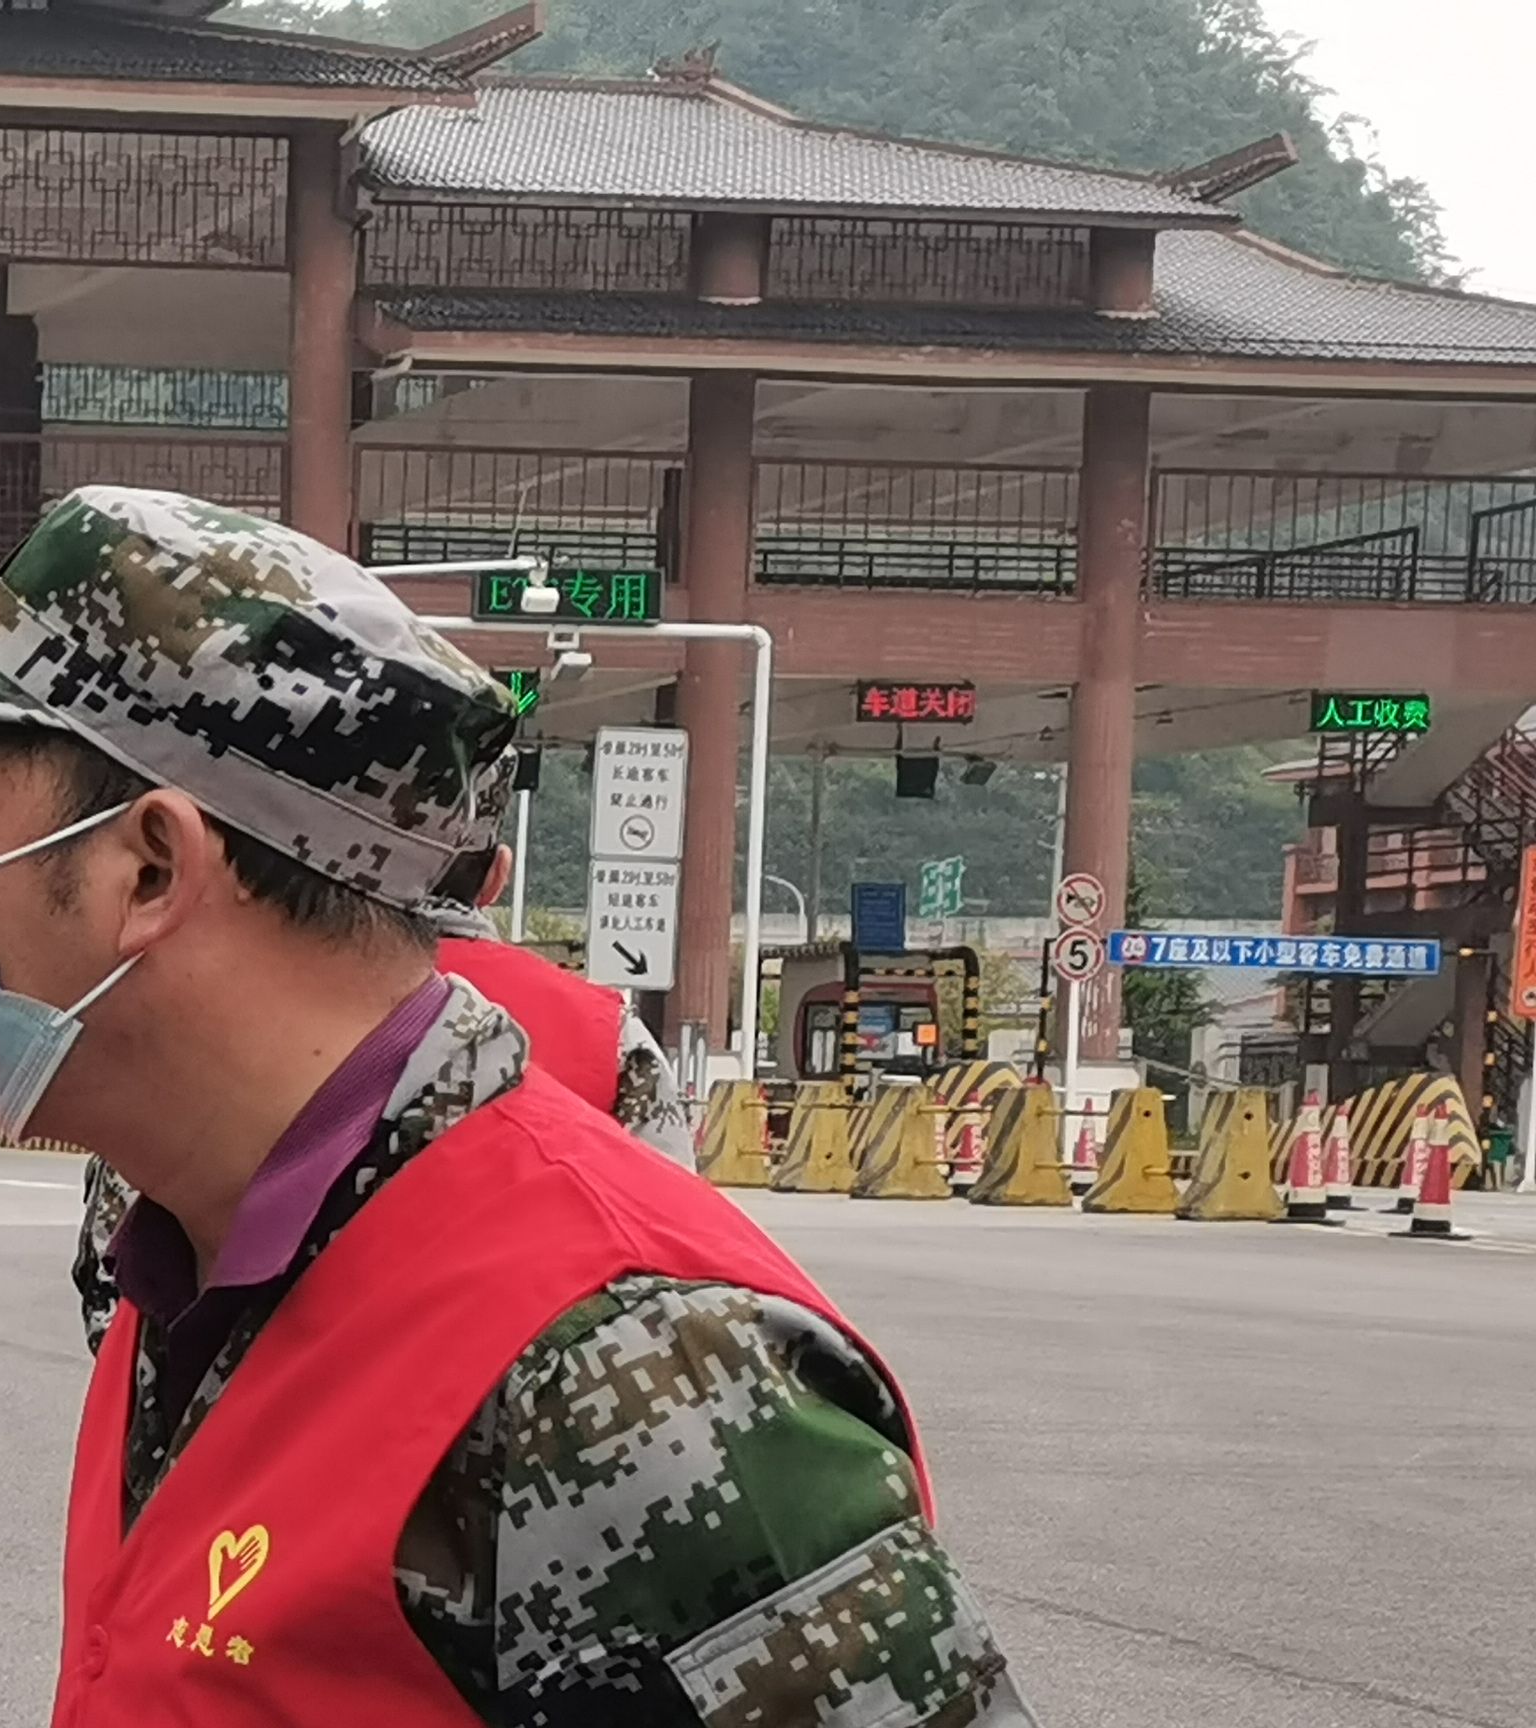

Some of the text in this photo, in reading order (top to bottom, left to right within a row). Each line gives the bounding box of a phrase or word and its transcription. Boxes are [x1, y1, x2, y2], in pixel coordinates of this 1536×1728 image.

[489, 571, 646, 620] E专用
[861, 686, 976, 718] 车道关闭
[1316, 697, 1428, 729] 人工收费
[1068, 939, 1089, 971] 5
[1150, 937, 1429, 970] 7座及以下小型客车免费通道
